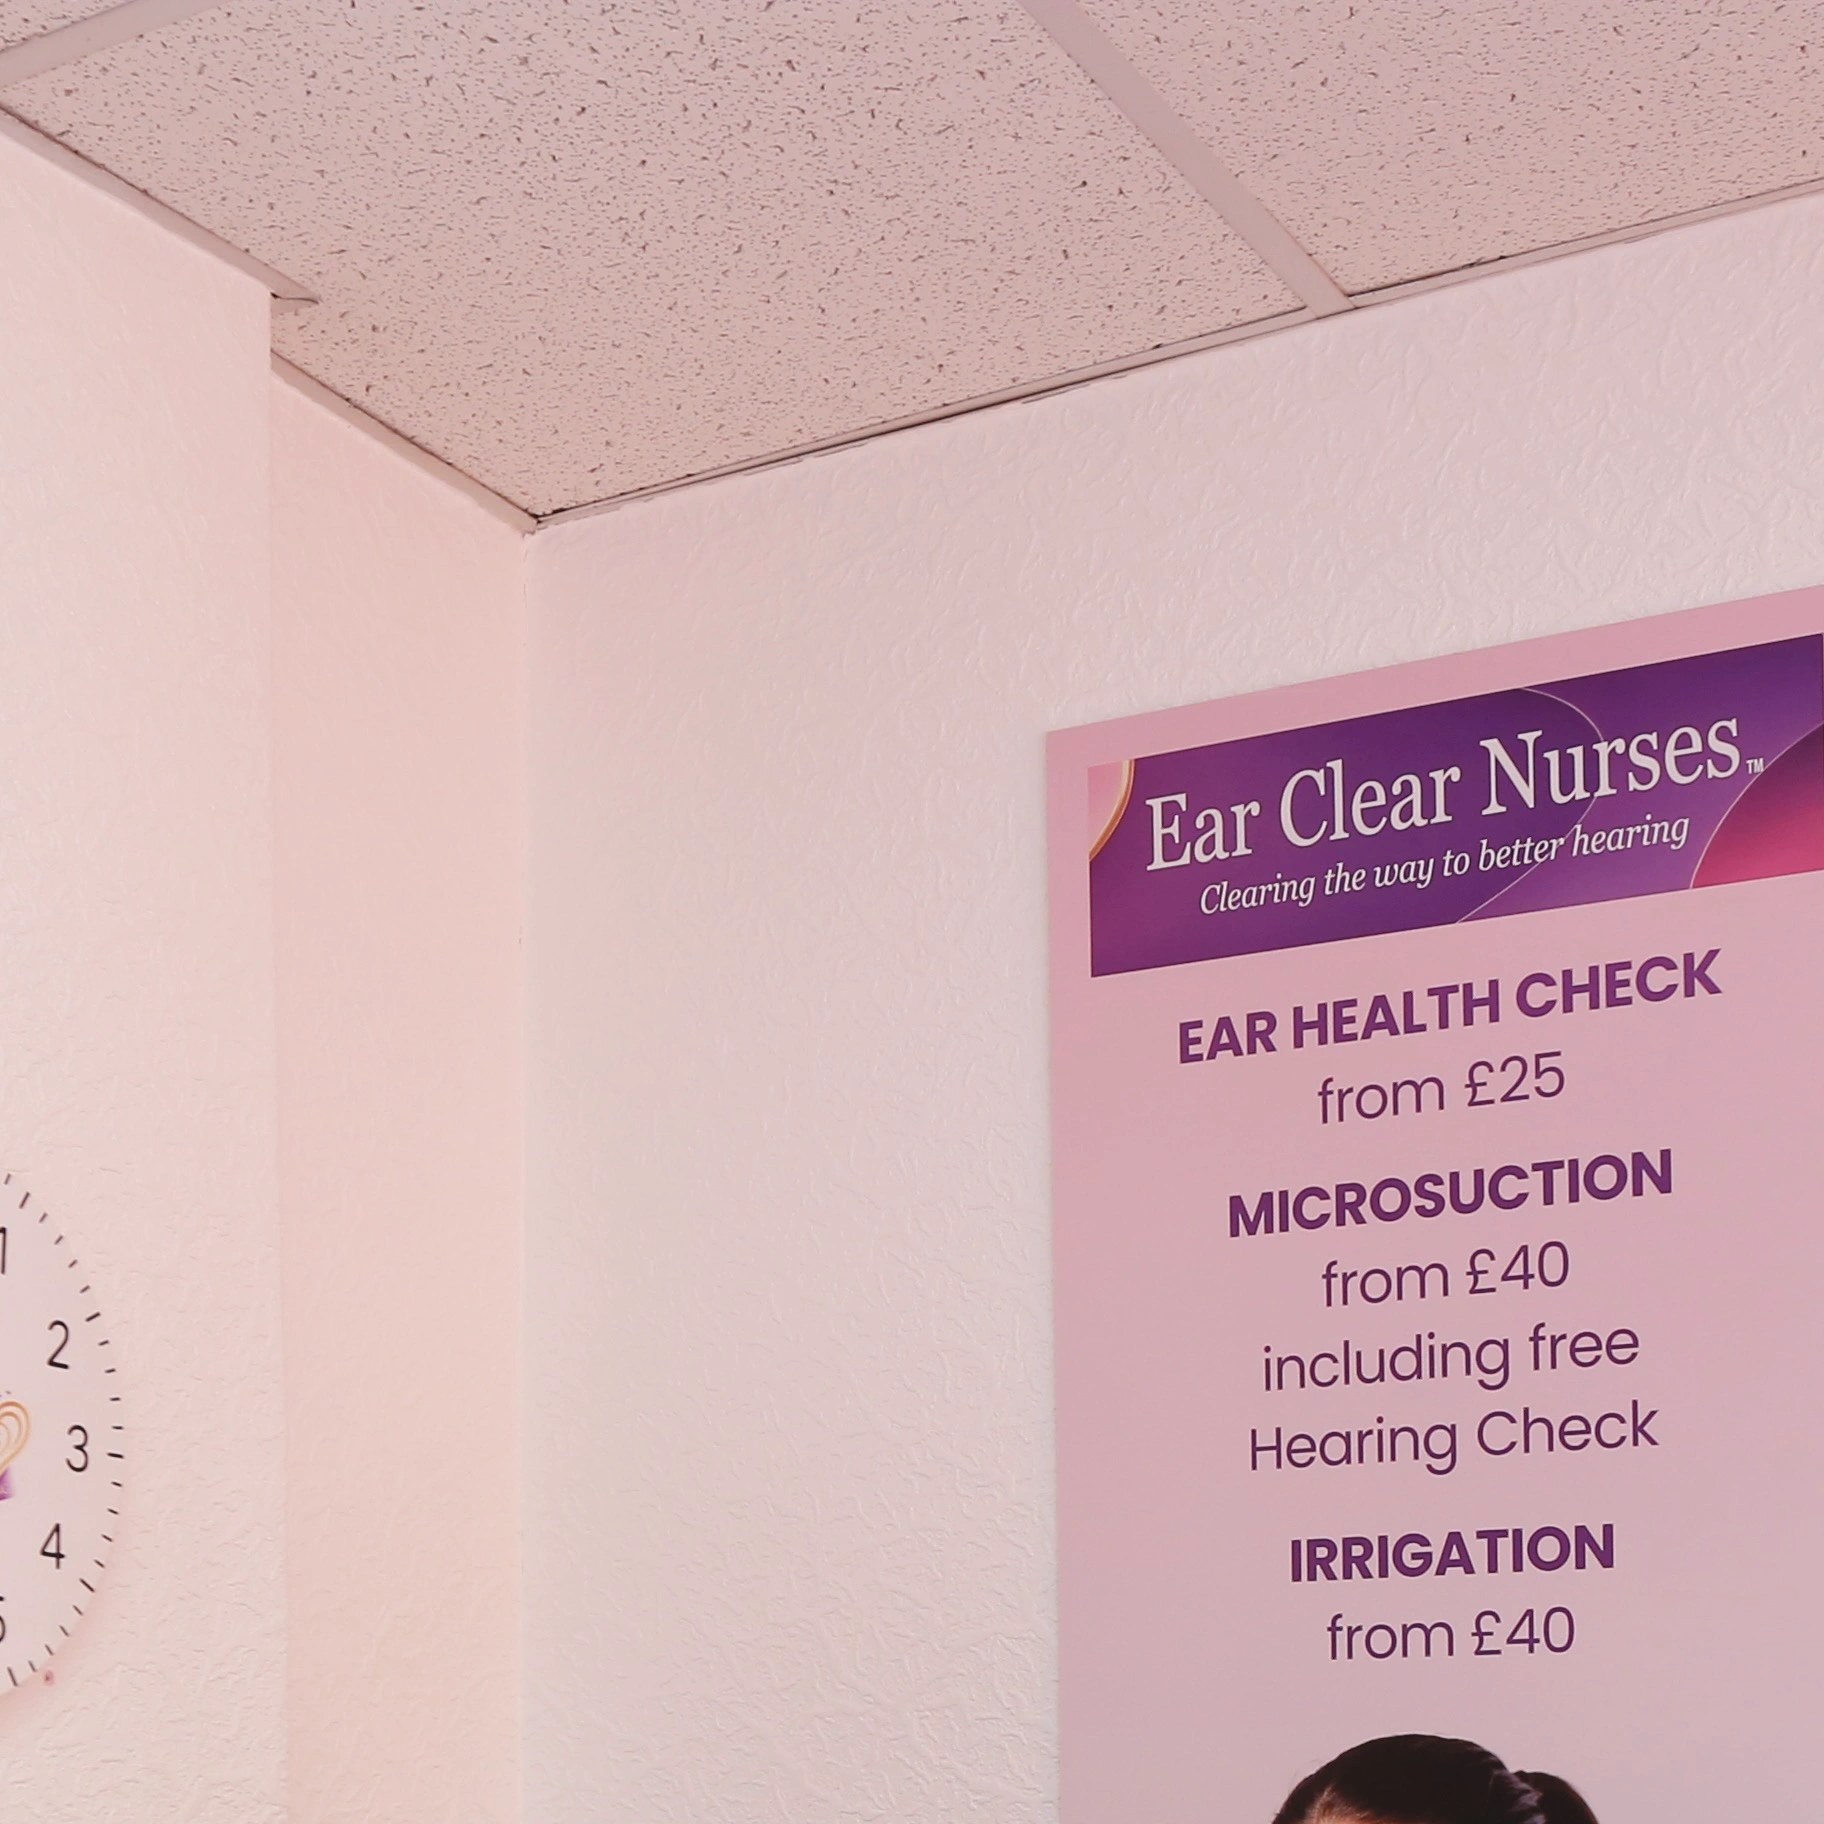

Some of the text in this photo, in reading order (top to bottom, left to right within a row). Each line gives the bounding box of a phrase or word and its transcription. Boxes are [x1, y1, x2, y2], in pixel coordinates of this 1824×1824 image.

[1144, 790, 1261, 871] Ear
[1278, 758, 1463, 849] Clear
[1479, 716, 1742, 817] Nurses
[1198, 813, 1691, 917] Clearing the way to better hearing
[1178, 947, 1722, 1064] EAR HEALTH CHECK
[1317, 1050, 1566, 1125] from £25
[1228, 1148, 1673, 1238] MICROSUCTION
[1322, 1240, 1570, 1307] from £40
[46, 1320, 69, 1369] 2
[1263, 1322, 1641, 1391] including free
[66, 1425, 90, 1472] 3
[1250, 1399, 1659, 1475] Hearing Check
[40, 1523, 65, 1569] 4
[1289, 1523, 1615, 1583] IRRIGATION
[1327, 1606, 1576, 1660] from £40
